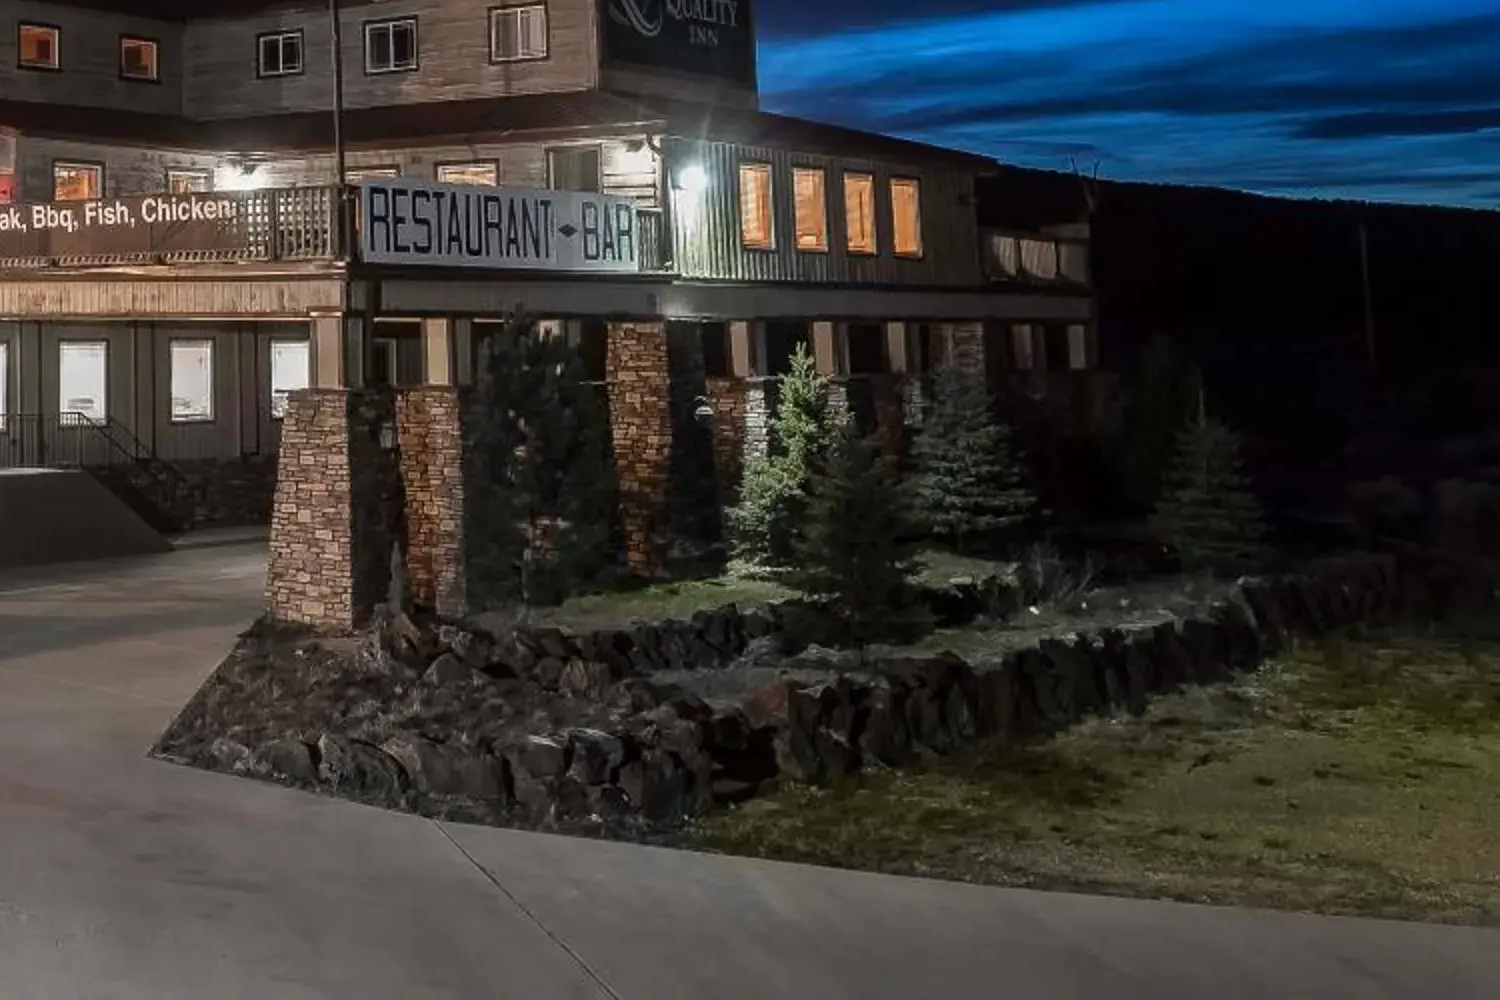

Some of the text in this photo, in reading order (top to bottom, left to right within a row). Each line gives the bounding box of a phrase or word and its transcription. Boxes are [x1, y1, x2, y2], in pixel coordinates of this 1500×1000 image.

[689, 24, 719, 47] INN
[32, 205, 79, 233] Bbq,
[85, 202, 135, 228] Fish,
[141, 198, 231, 223] Chicken
[368, 186, 634, 261] RESTAURANT BAR
